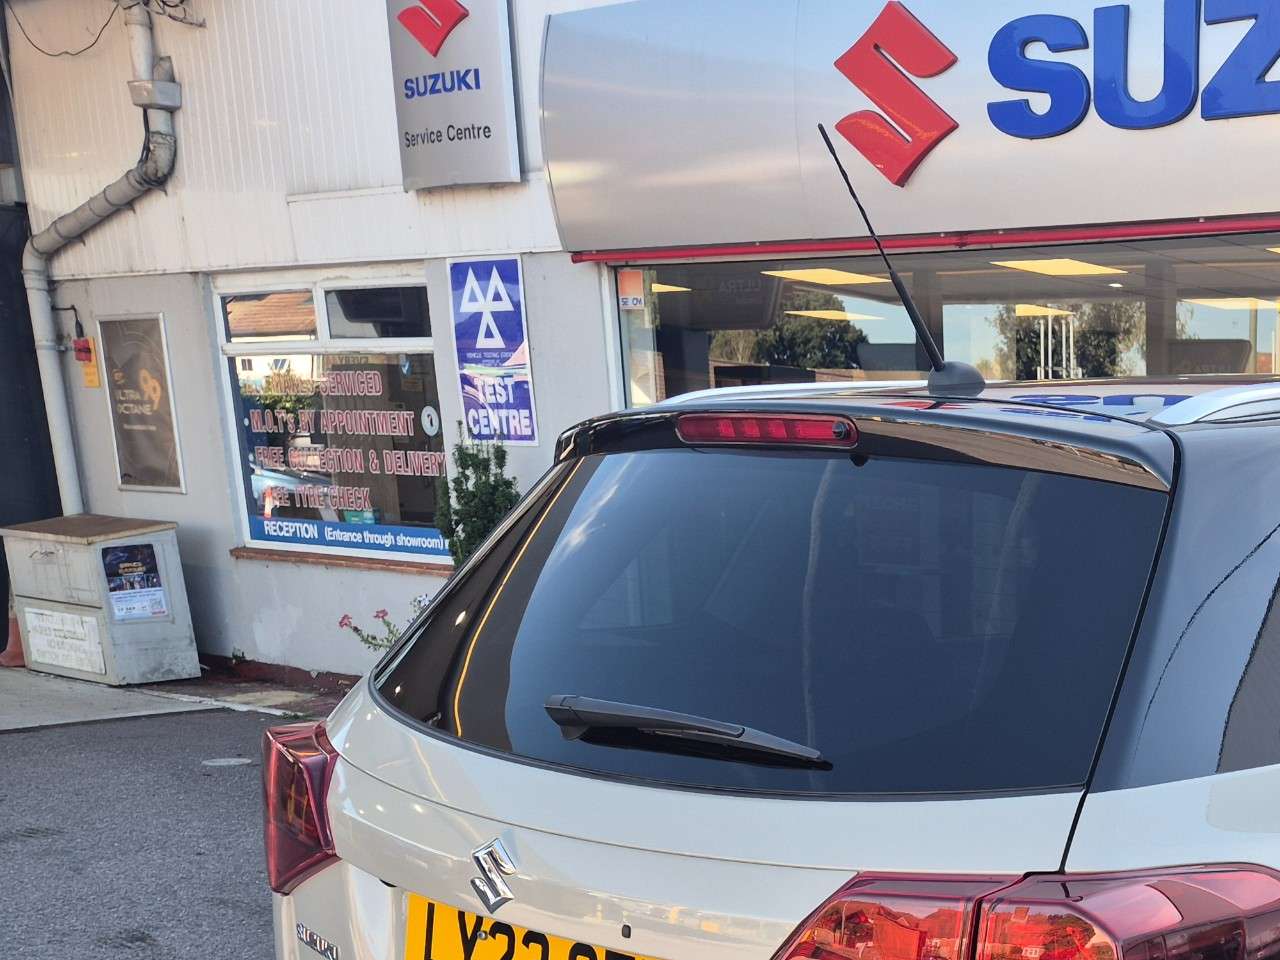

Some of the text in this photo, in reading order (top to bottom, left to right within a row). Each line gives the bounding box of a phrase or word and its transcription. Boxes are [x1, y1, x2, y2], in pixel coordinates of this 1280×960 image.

[404, 68, 480, 99] SUZUKI
[404, 123, 492, 148] Service Centre
[319, 370, 383, 396] SERVICED
[473, 376, 515, 404] TEST
[299, 409, 316, 434] BY
[320, 410, 416, 436] APPOINTMENT
[467, 408, 532, 436] CENTRE
[255, 445, 286, 471] FREE
[368, 449, 381, 474] &
[382, 449, 448, 477] DELIVERY
[327, 486, 373, 511] CHECK
[263, 520, 444, 551] RECEPTION (Entrance through showroom)
